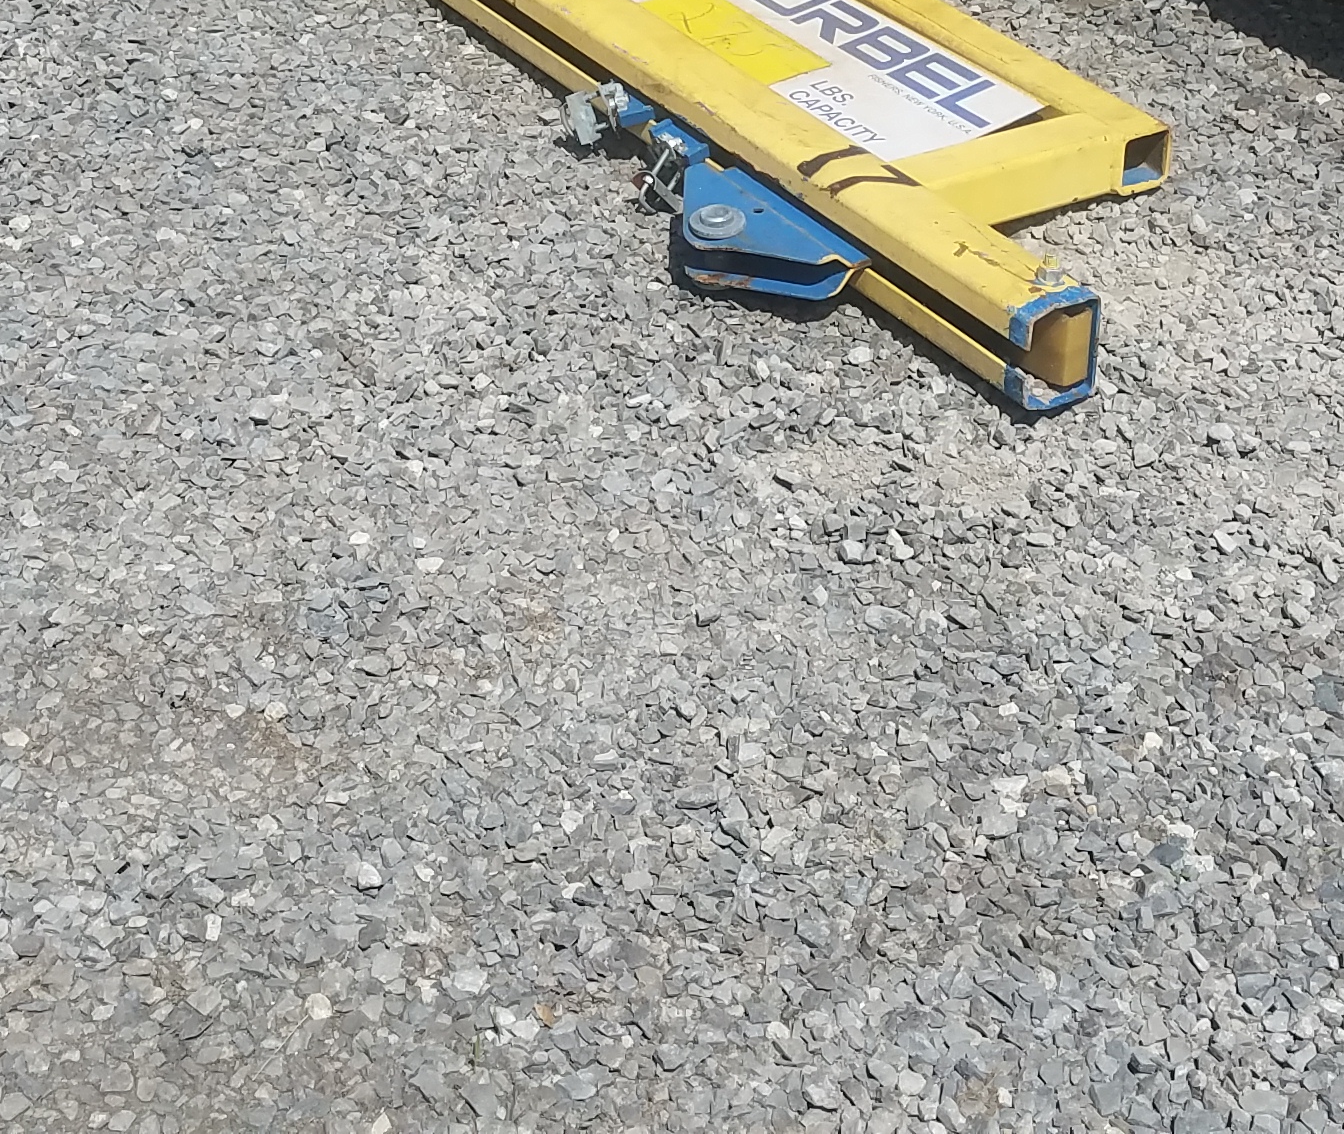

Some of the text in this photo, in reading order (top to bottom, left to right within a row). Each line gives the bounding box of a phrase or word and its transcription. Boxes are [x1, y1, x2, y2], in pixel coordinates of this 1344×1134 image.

[788, 90, 887, 143] CAPACITY
[809, 80, 855, 106] LBS.
[797, 144, 924, 196] 17
